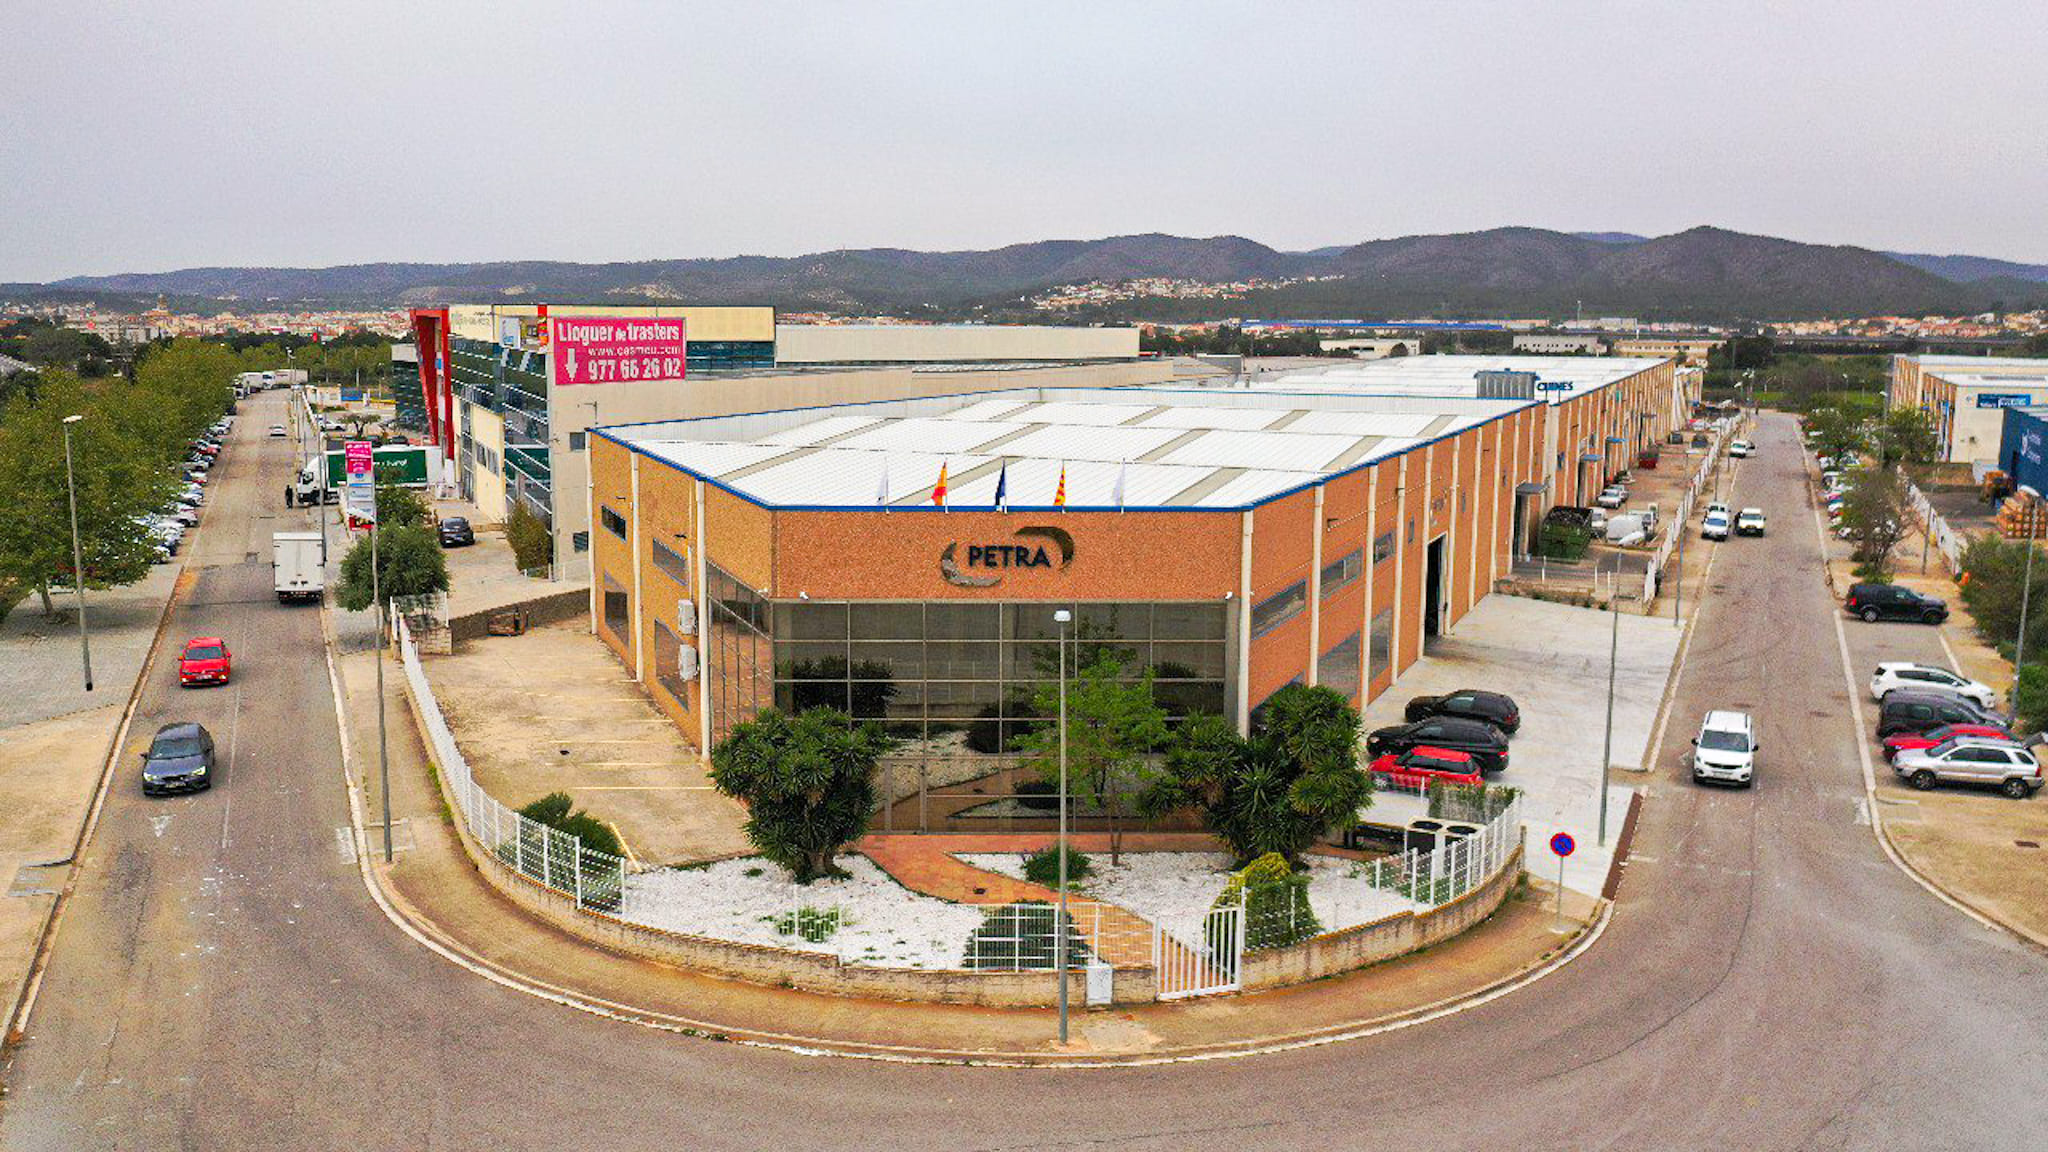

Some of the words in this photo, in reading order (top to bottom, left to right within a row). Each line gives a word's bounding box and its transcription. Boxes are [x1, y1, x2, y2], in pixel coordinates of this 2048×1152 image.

[558, 322, 614, 346] Lloguer
[627, 322, 680, 341] trasters
[588, 359, 617, 381] 977
[620, 359, 640, 380] 66
[642, 357, 660, 379] 26
[663, 357, 682, 378] 02
[968, 545, 1052, 567] PETRA
